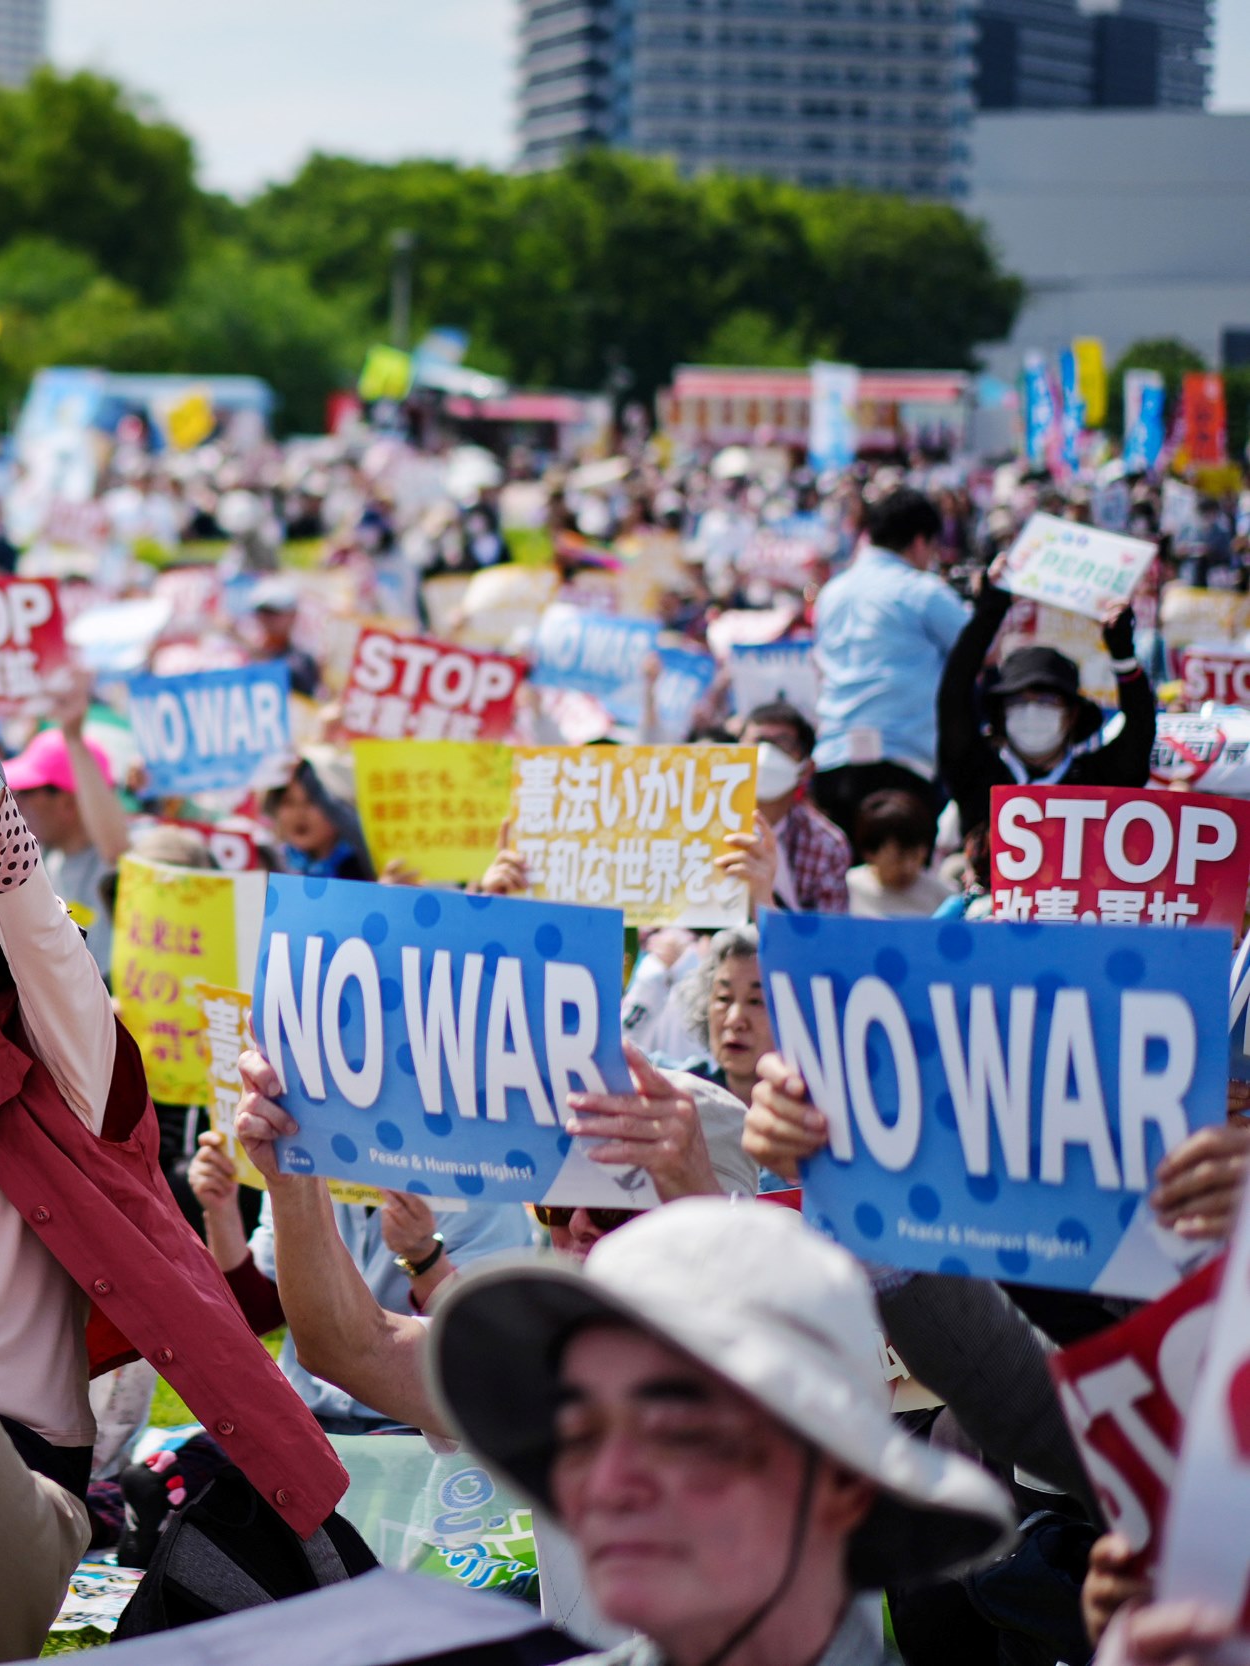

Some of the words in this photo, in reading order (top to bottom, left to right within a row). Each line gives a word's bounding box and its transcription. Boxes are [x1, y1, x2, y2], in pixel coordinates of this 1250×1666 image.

[354, 634, 515, 714] STOP
[1184, 657, 1250, 703] STO
[129, 692, 186, 763] NO
[184, 683, 286, 756] WAR
[514, 756, 751, 832] 憲法いかして
[516, 838, 715, 904] 平和な世界を
[996, 796, 1238, 886] STOP
[262, 931, 384, 1108] NO
[400, 945, 610, 1127] WAR
[769, 971, 922, 1172] NO
[928, 984, 1197, 1192] WAR
[369, 1148, 410, 1169] Peace
[411, 1154, 423, 1171] &
[425, 1158, 477, 1176] Human
[479, 1161, 533, 1183] Rights!
[897, 1217, 944, 1241] Peace
[947, 1223, 960, 1245] &
[963, 1226, 1023, 1250] Human
[1026, 1233, 1085, 1260] Rights!
